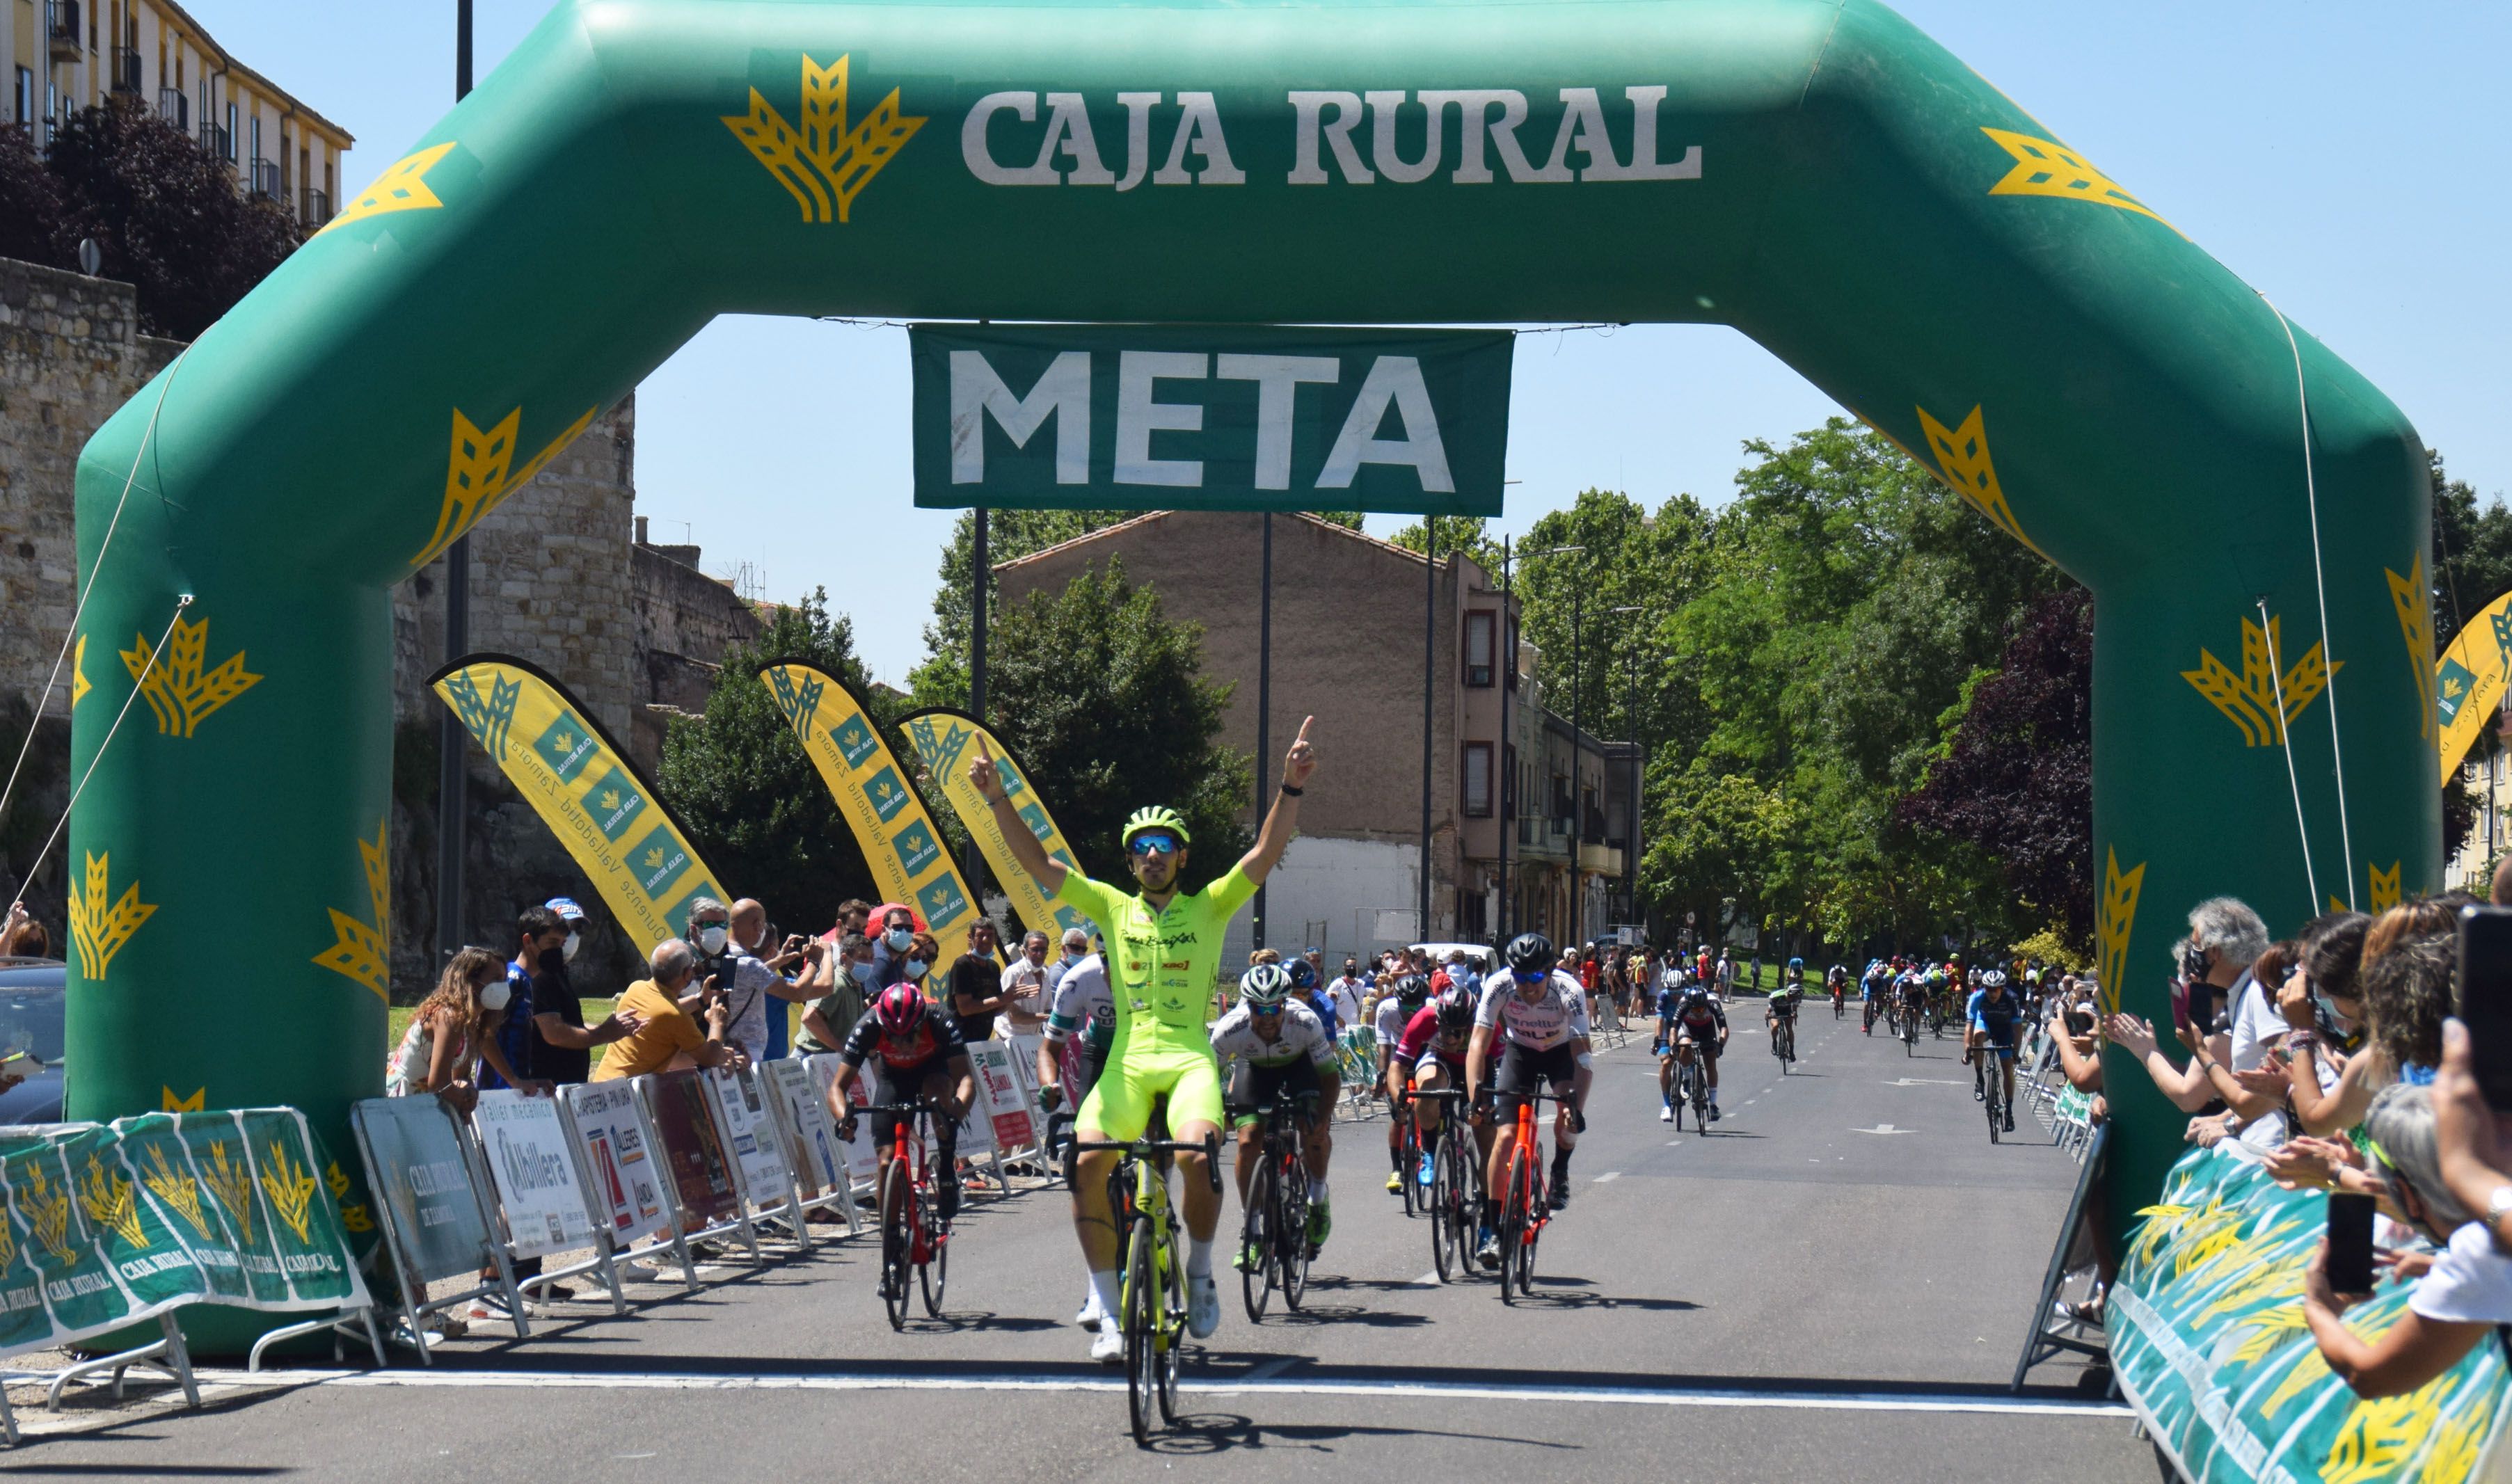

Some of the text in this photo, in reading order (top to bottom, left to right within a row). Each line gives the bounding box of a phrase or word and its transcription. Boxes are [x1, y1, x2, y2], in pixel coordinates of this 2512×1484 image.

[961, 85, 1702, 192] CAJA RURAL
[949, 350, 1456, 493] META
[479, 1101, 509, 1122] Taller
[505, 1141, 569, 1190] Albillera
[120, 1250, 193, 1280] CAJA RURAL
[7, 1286, 40, 1311] RURAL
[47, 1271, 113, 1301] CAJA RURAL
